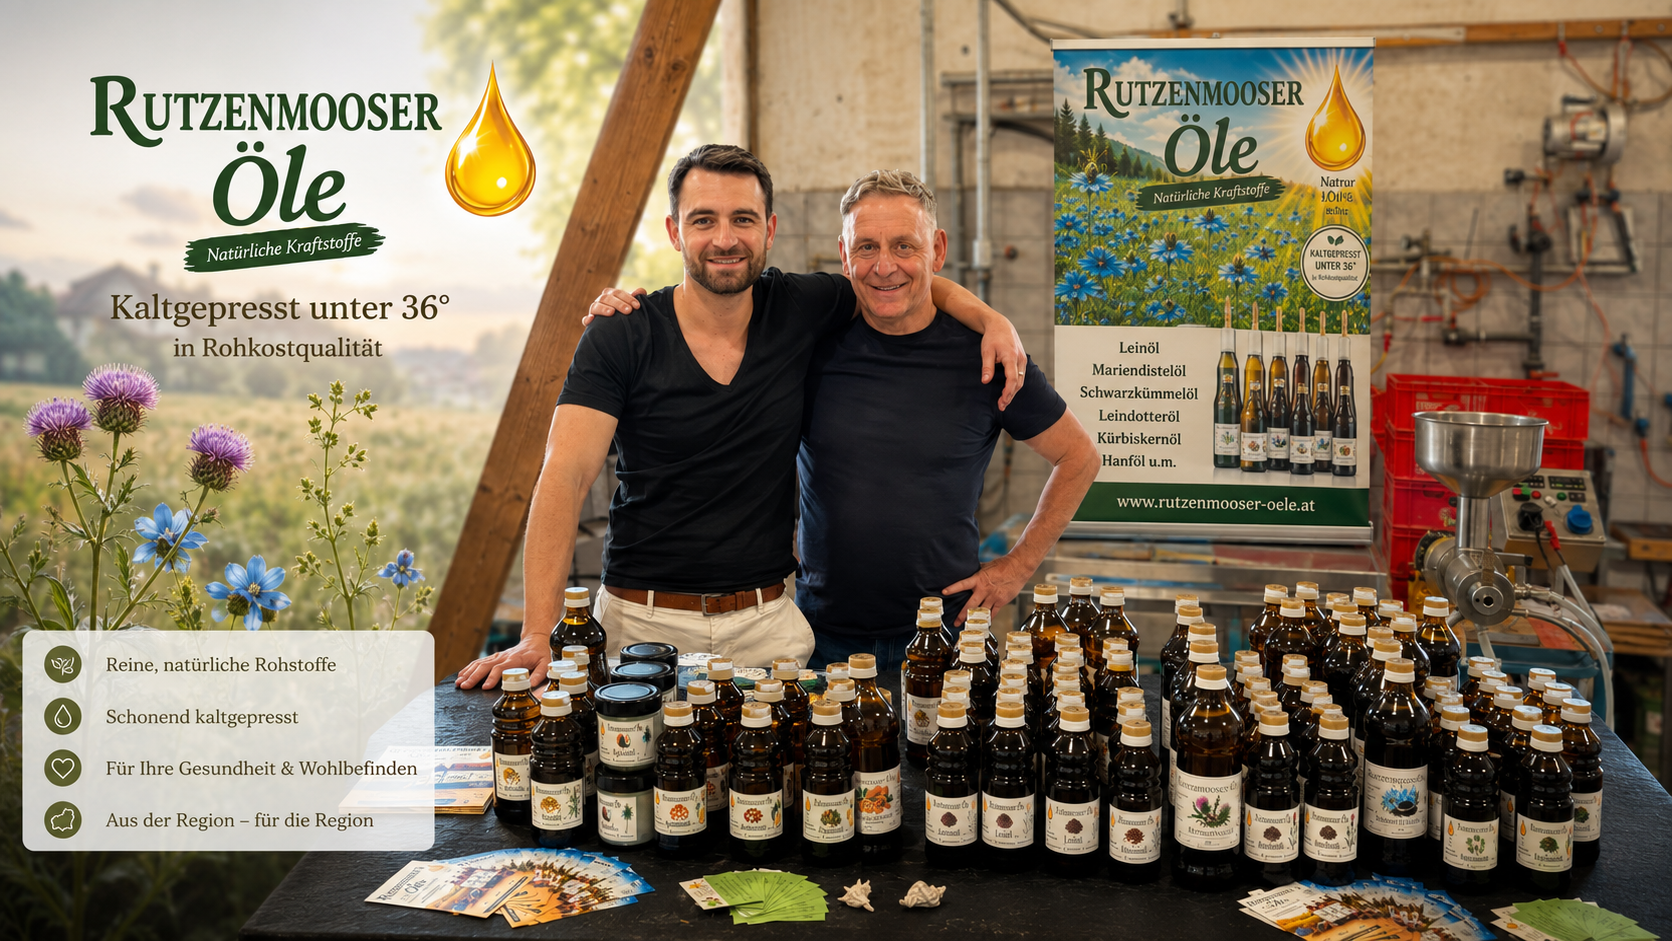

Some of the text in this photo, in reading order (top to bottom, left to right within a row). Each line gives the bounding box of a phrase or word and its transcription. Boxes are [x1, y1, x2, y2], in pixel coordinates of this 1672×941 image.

[1164, 114, 1259, 177] Öle
[1153, 182, 1270, 204] Natürliche Kraftstoffe
[1309, 249, 1362, 259] KALTGEPRESST
[1315, 261, 1341, 271] UNTER
[1119, 341, 1160, 354] Leinöl
[1092, 363, 1187, 377] Mariendistelöl
[1079, 385, 1199, 400] Schwarzkümmelöl
[1099, 409, 1180, 423] Leindotteröl
[1097, 431, 1182, 446] Kürbiskernöl
[1102, 454, 1177, 468] Hanföl u.m.
[1116, 496, 1315, 512] www.rutzenmooser-oele.at
